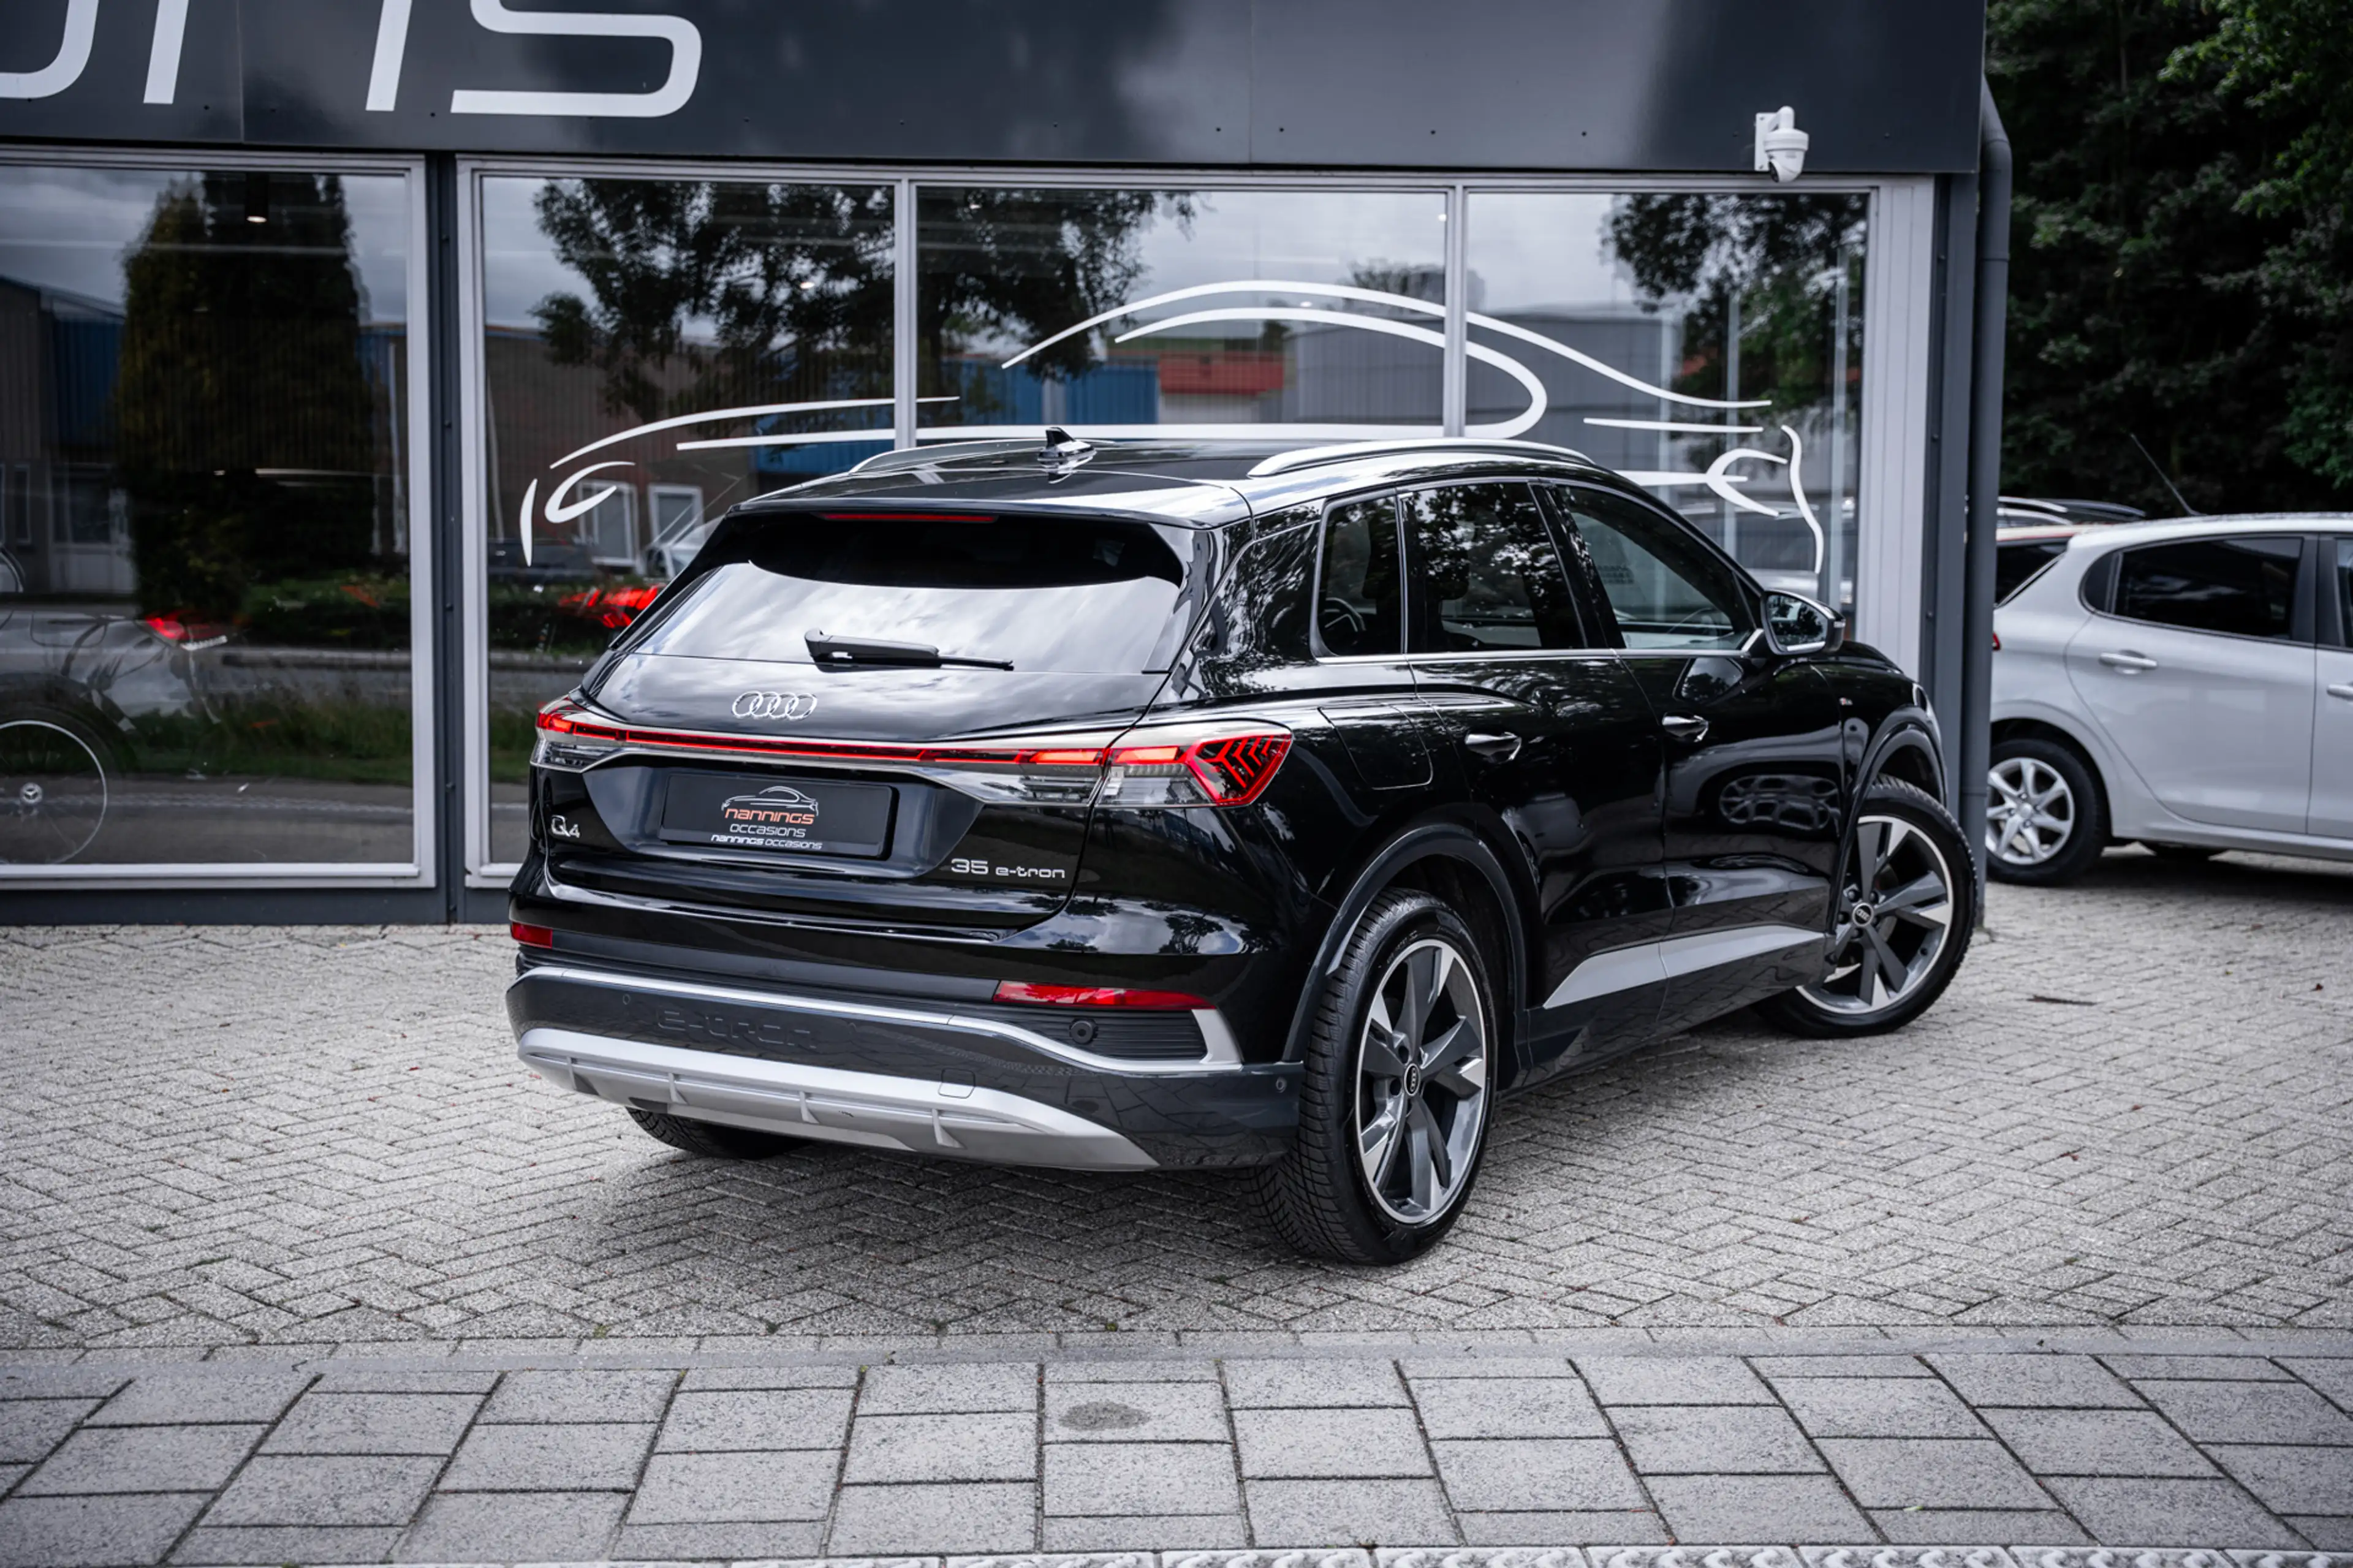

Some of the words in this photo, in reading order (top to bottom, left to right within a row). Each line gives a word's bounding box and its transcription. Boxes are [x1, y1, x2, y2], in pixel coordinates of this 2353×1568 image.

[551, 814, 580, 838] Q4
[730, 824, 806, 838] occasions
[951, 858, 988, 874] 35
[996, 866, 1066, 878] e-tron
